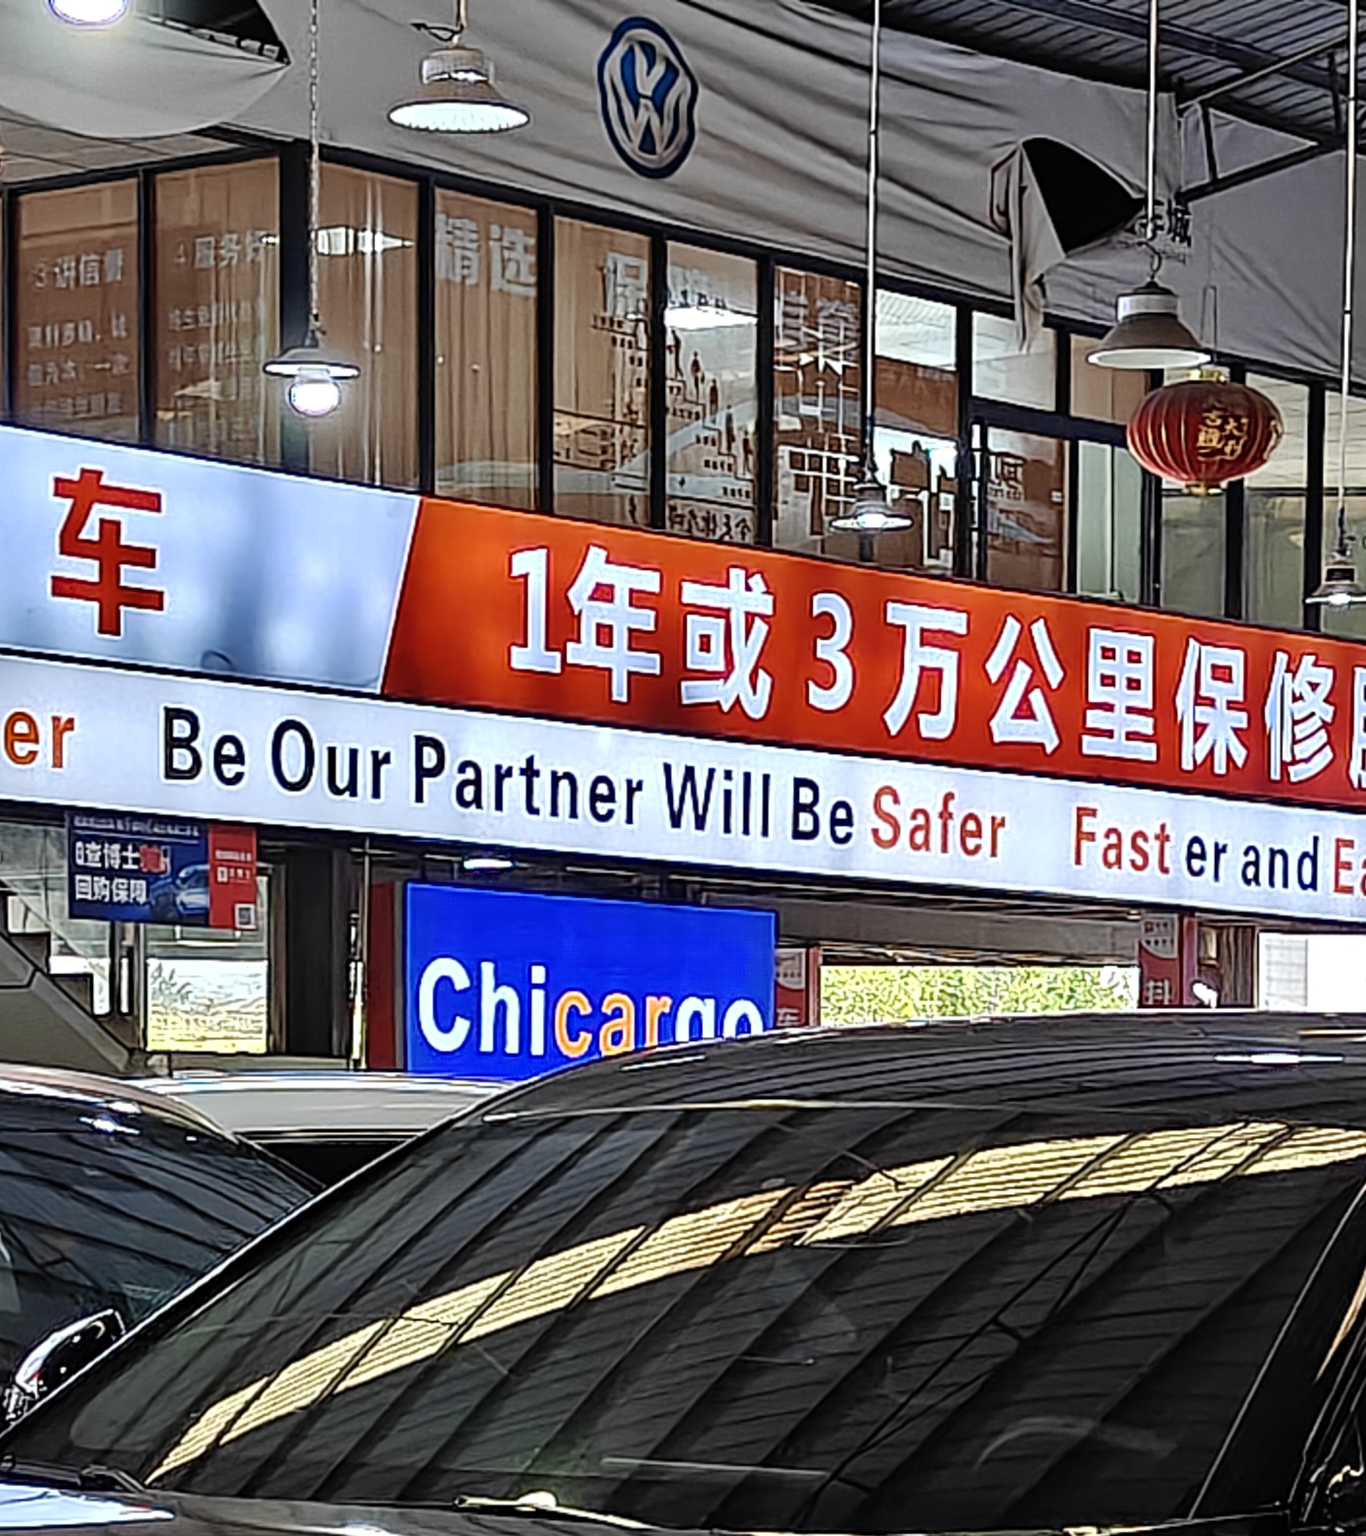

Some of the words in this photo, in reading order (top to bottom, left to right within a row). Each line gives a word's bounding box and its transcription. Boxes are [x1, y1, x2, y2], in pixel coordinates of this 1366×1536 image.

[162, 706, 247, 786] Be
[271, 718, 392, 801] Our
[413, 734, 643, 823] Partner
[663, 762, 771, 840] Will
[790, 777, 855, 845] Be
[870, 785, 1007, 859] Safer
[1240, 834, 1321, 895] and
[418, 957, 764, 1058] Chicargo
